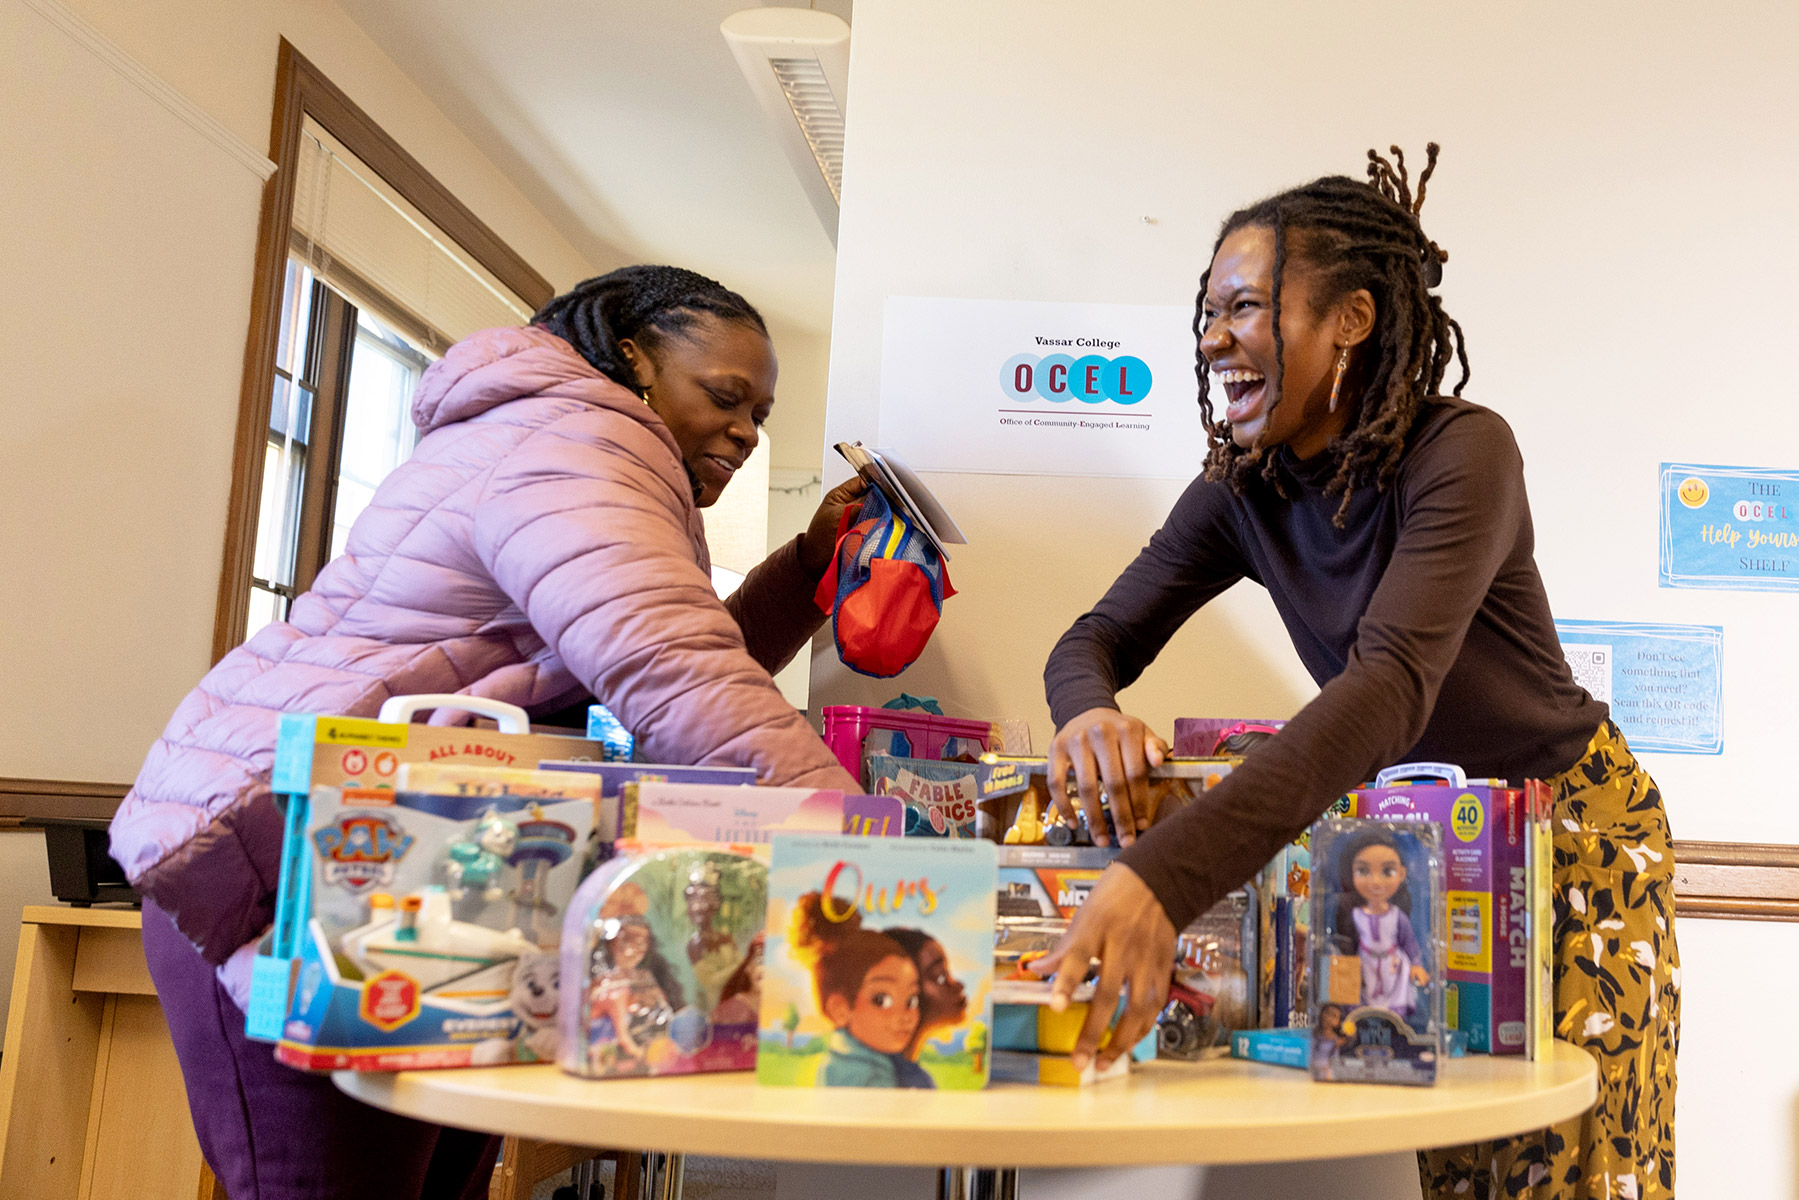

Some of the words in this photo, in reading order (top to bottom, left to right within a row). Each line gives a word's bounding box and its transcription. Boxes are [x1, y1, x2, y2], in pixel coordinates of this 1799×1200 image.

[1035, 337, 1073, 346] Vassar
[1076, 338, 1120, 350] College
[1014, 363, 1132, 396] OCEL
[1000, 418, 1023, 426] Office
[1034, 419, 1113, 430] Community-Engaged
[1115, 422, 1150, 430] Learning
[1749, 482, 1781, 496] THE
[1739, 505, 1788, 519] OCEL
[1700, 523, 1742, 548] Help
[1740, 557, 1790, 572] SHELF
[1637, 651, 1666, 661] Don't
[1668, 653, 1686, 662] see
[1622, 668, 1677, 679] something
[1680, 668, 1700, 679] that
[1635, 686, 1654, 694] you
[1656, 684, 1688, 694] need?
[1614, 698, 1639, 707] Scan
[1641, 699, 1662, 708] this
[1664, 700, 1681, 711] QR
[1684, 701, 1708, 710] code
[1623, 714, 1643, 724] and
[1646, 717, 1684, 727] request
[430, 745, 457, 761] ALL
[463, 745, 516, 765] ABOUT
[909, 778, 964, 803] FABLE
[1378, 795, 1410, 811] MATCHING
[1457, 806, 1478, 824] 40
[314, 827, 414, 860] PAW
[820, 861, 947, 923] Ours
[1509, 867, 1525, 968] MATCH
